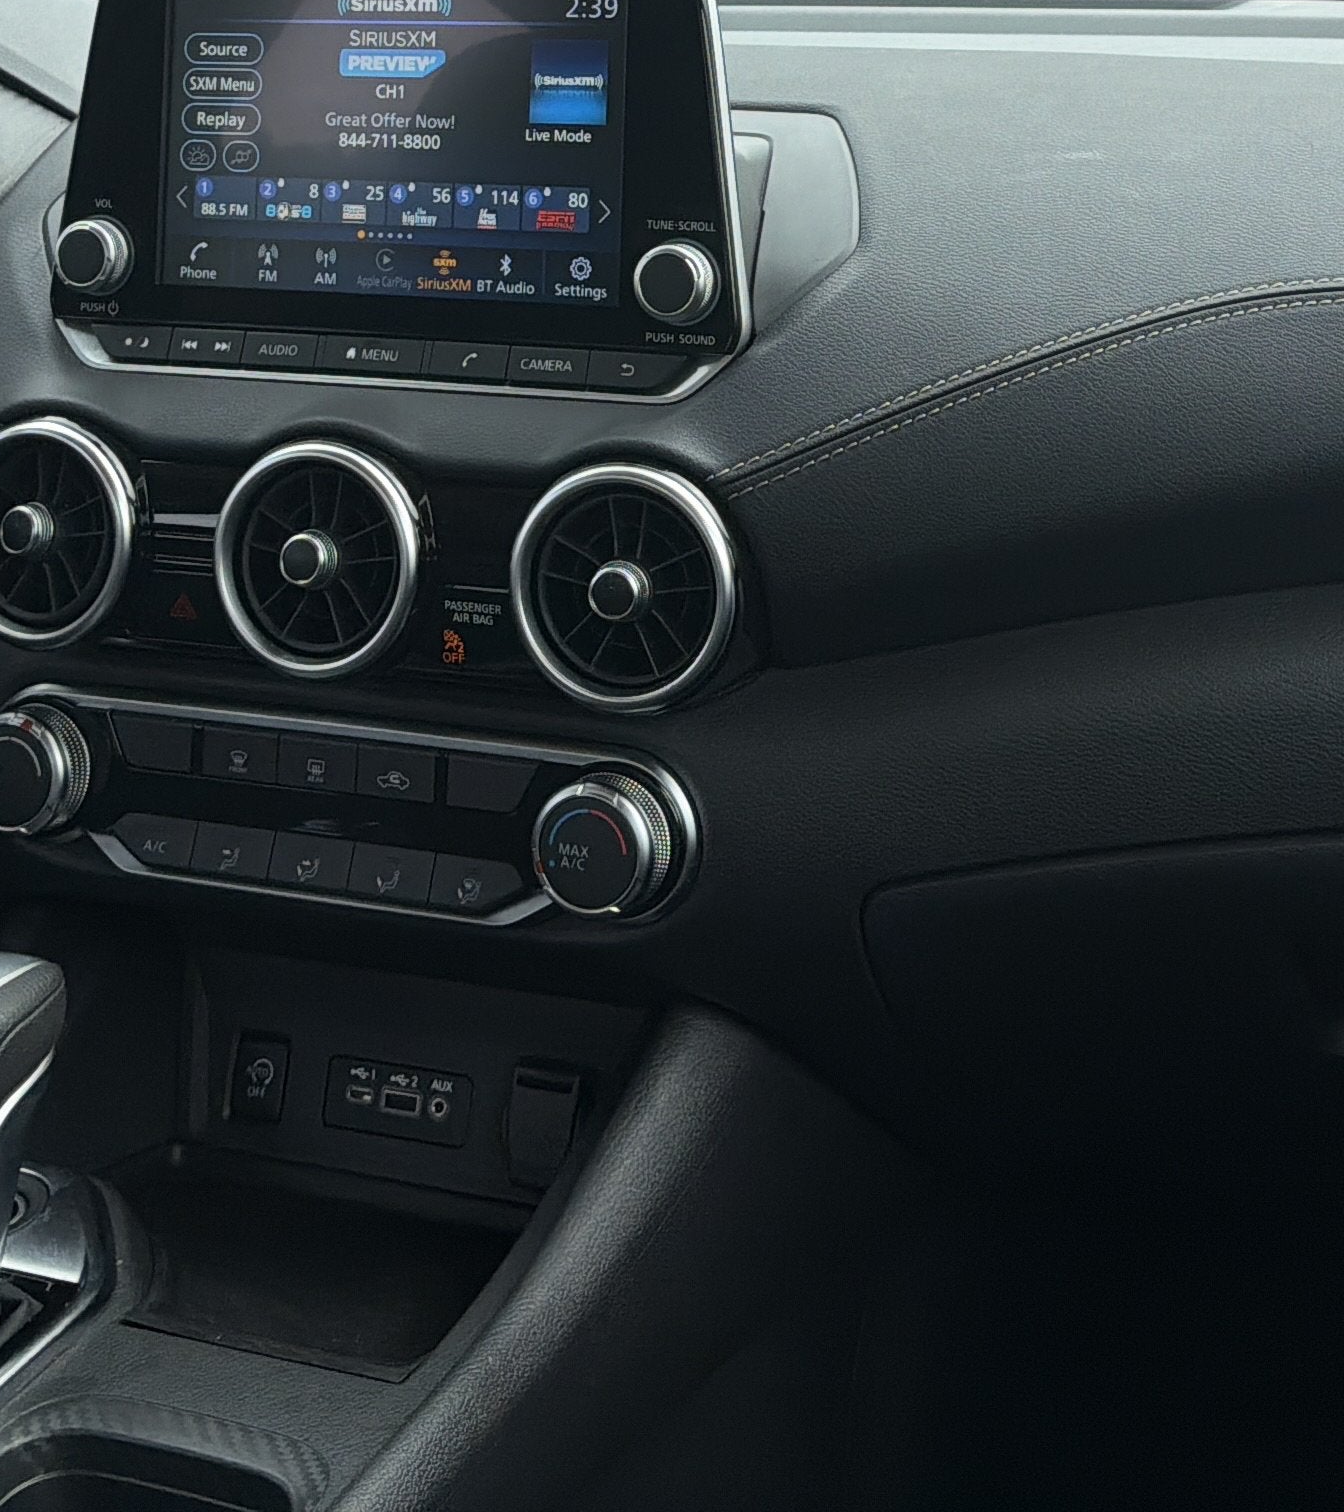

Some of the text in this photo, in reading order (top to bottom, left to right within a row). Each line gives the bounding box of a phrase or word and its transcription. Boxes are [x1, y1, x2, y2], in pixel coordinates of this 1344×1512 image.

[199, 41, 248, 57] Source
[348, 55, 437, 72] PREVIEW
[189, 76, 255, 92] SXM Menu
[375, 84, 405, 100] CH1
[196, 110, 246, 130] Replay
[325, 112, 455, 130] Great Offer Now!
[338, 132, 441, 150] 844-711-8800
[525, 129, 592, 143] Live Mode
[264, 183, 319, 199] 2 8
[328, 185, 385, 201] 3 25
[393, 188, 451, 204] 4 56
[462, 189, 519, 206] 5 114
[95, 198, 113, 209] VOL
[529, 192, 589, 208] 6 80
[201, 203, 248, 217] 88.5 FM
[402, 210, 438, 227] highway
[180, 266, 217, 280] Phone
[258, 269, 278, 283] FM
[314, 272, 337, 285] AM
[357, 275, 412, 290] Apple CarPlay
[417, 276, 472, 291] SiriusXM
[476, 279, 535, 295] BT Audio
[554, 283, 608, 302] Settings
[80, 302, 106, 313] PUSH
[645, 332, 716, 346] PUSH SOUND
[259, 344, 299, 357] AUDIO
[361, 348, 399, 362] MENU
[520, 358, 573, 373] CAMERA
[444, 599, 502, 615] PASSENGER
[452, 612, 494, 626] AIR BAG
[442, 651, 466, 664] OFF
[143, 840, 166, 855] A/C
[558, 842, 590, 858] MAX
[560, 855, 586, 871] A/C
[410, 1075, 419, 1088] 2
[430, 1078, 454, 1093] AUX
